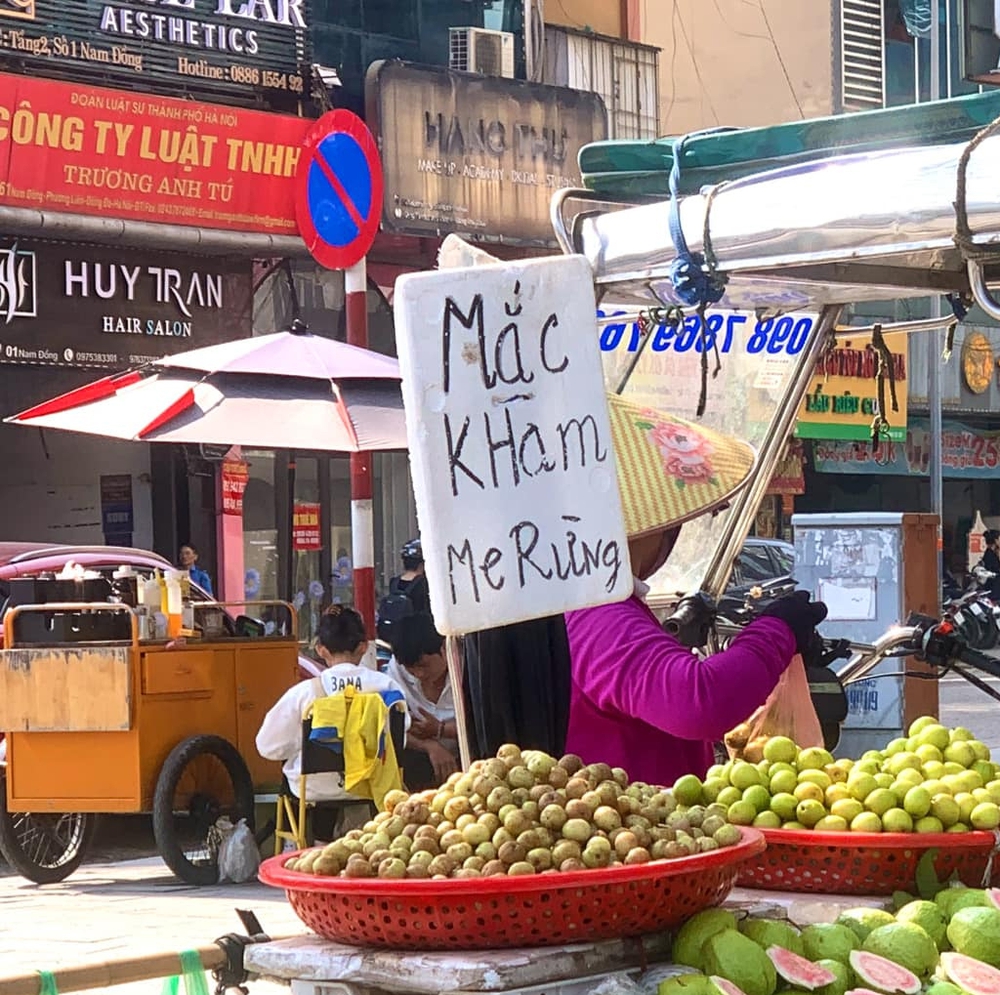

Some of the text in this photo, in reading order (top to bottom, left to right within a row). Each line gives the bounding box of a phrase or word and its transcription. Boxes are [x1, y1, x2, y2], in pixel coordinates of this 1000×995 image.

[80, 42, 109, 63] Nam
[101, 6, 259, 54] AESTHETICS
[94, 120, 135, 157] TY
[139, 125, 219, 172] LUẬT
[226, 138, 301, 177] TNHH
[63, 164, 234, 202] TRƯƠNG ANH TÚ
[64, 260, 224, 318] HUY TRAN
[102, 316, 192, 337] HAIR SALON
[443, 280, 570, 393] Mắc
